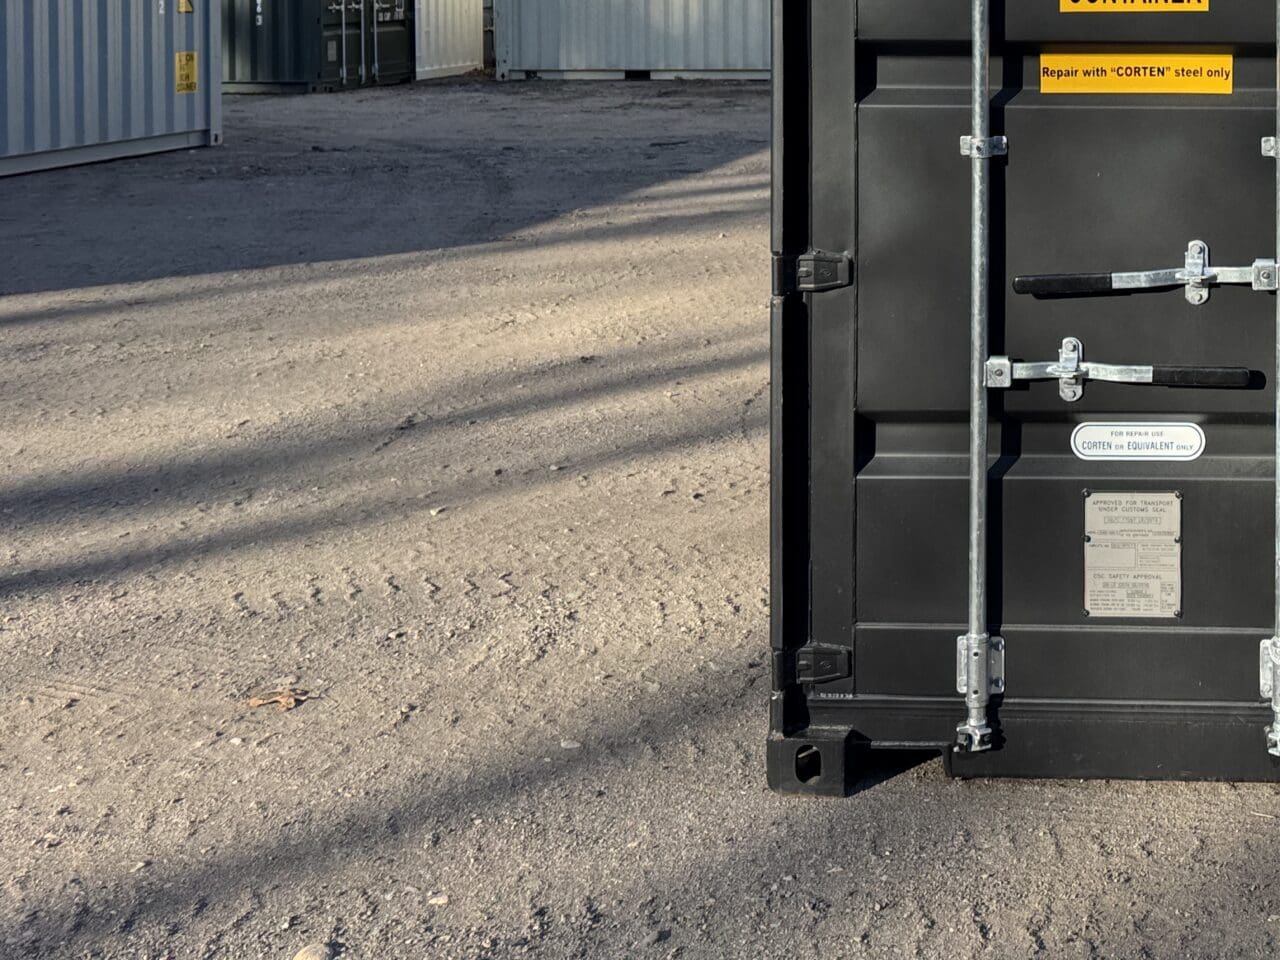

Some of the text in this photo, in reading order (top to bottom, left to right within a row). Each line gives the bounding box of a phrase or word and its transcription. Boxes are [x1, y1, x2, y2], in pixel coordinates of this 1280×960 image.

[1042, 67, 1078, 79] Repair
[1082, 66, 1107, 77] with
[1174, 66, 1203, 78] steel
[1206, 67, 1231, 80] only
[1082, 441, 1112, 450] CORTEN
[1127, 441, 1175, 450] EQUIVALENT
